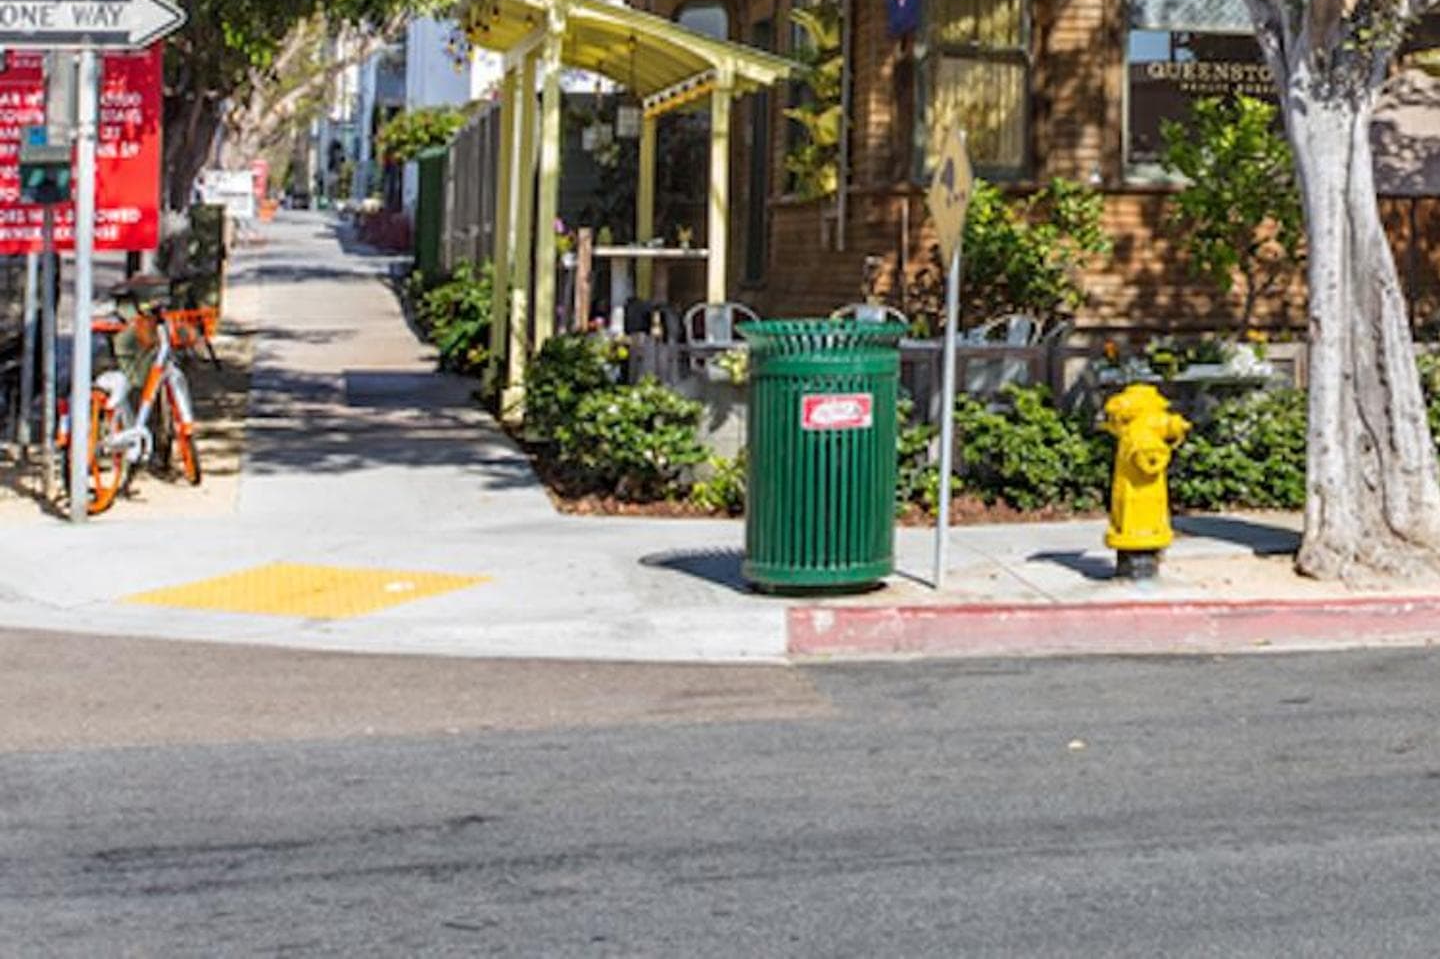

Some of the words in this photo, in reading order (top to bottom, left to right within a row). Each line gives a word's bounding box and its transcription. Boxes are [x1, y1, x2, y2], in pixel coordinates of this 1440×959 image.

[0, 4, 55, 27] ONE
[71, 5, 124, 27] WAY
[1146, 61, 1274, 82] QUEENSTO
